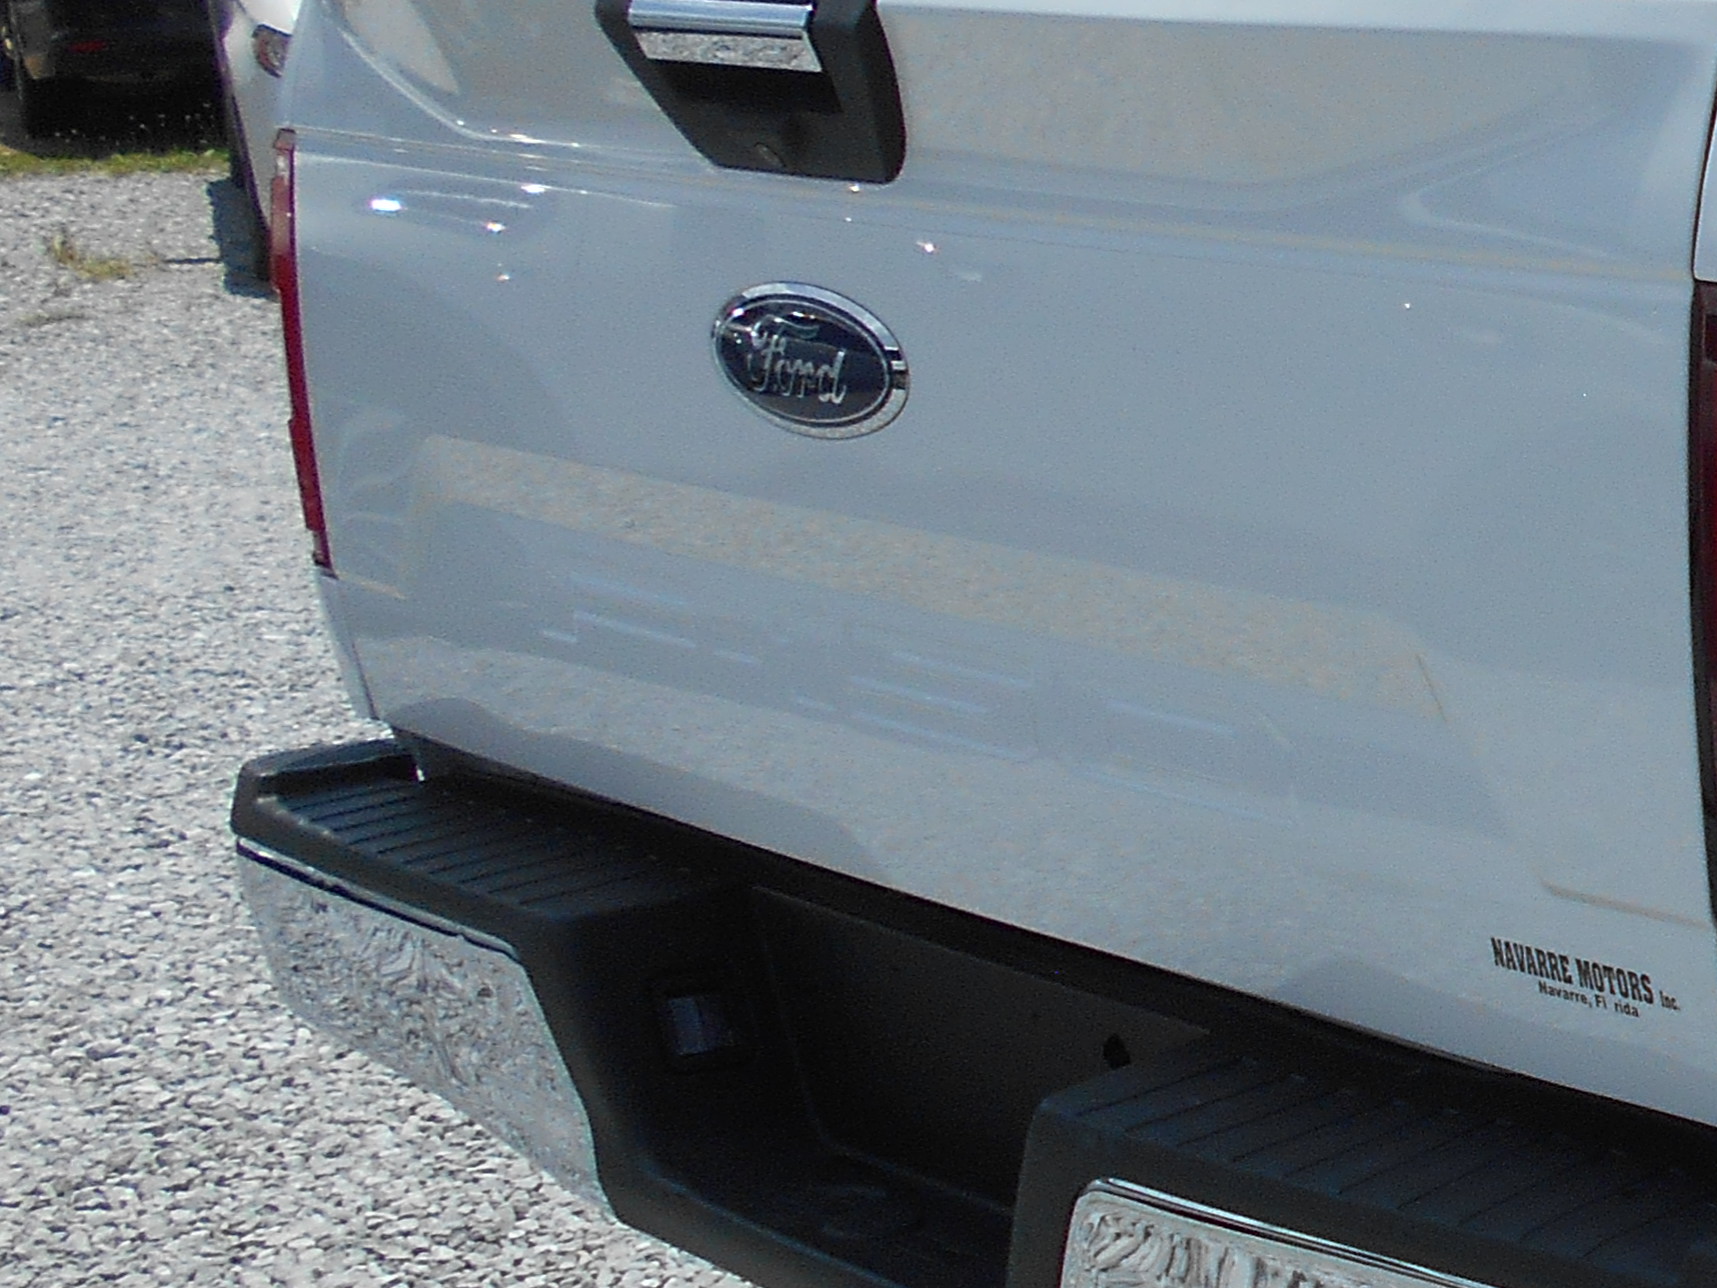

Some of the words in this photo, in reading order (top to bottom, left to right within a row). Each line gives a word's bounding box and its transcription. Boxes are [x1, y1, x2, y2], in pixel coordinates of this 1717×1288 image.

[747, 314, 847, 404] Ford
[1491, 937, 1573, 985] NAVARRE
[1575, 958, 1655, 1004] MOTORS
[1659, 990, 1681, 1011] Inc.
[1538, 980, 1593, 1009] Navarre,
[1595, 992, 1640, 1018] Flrida
